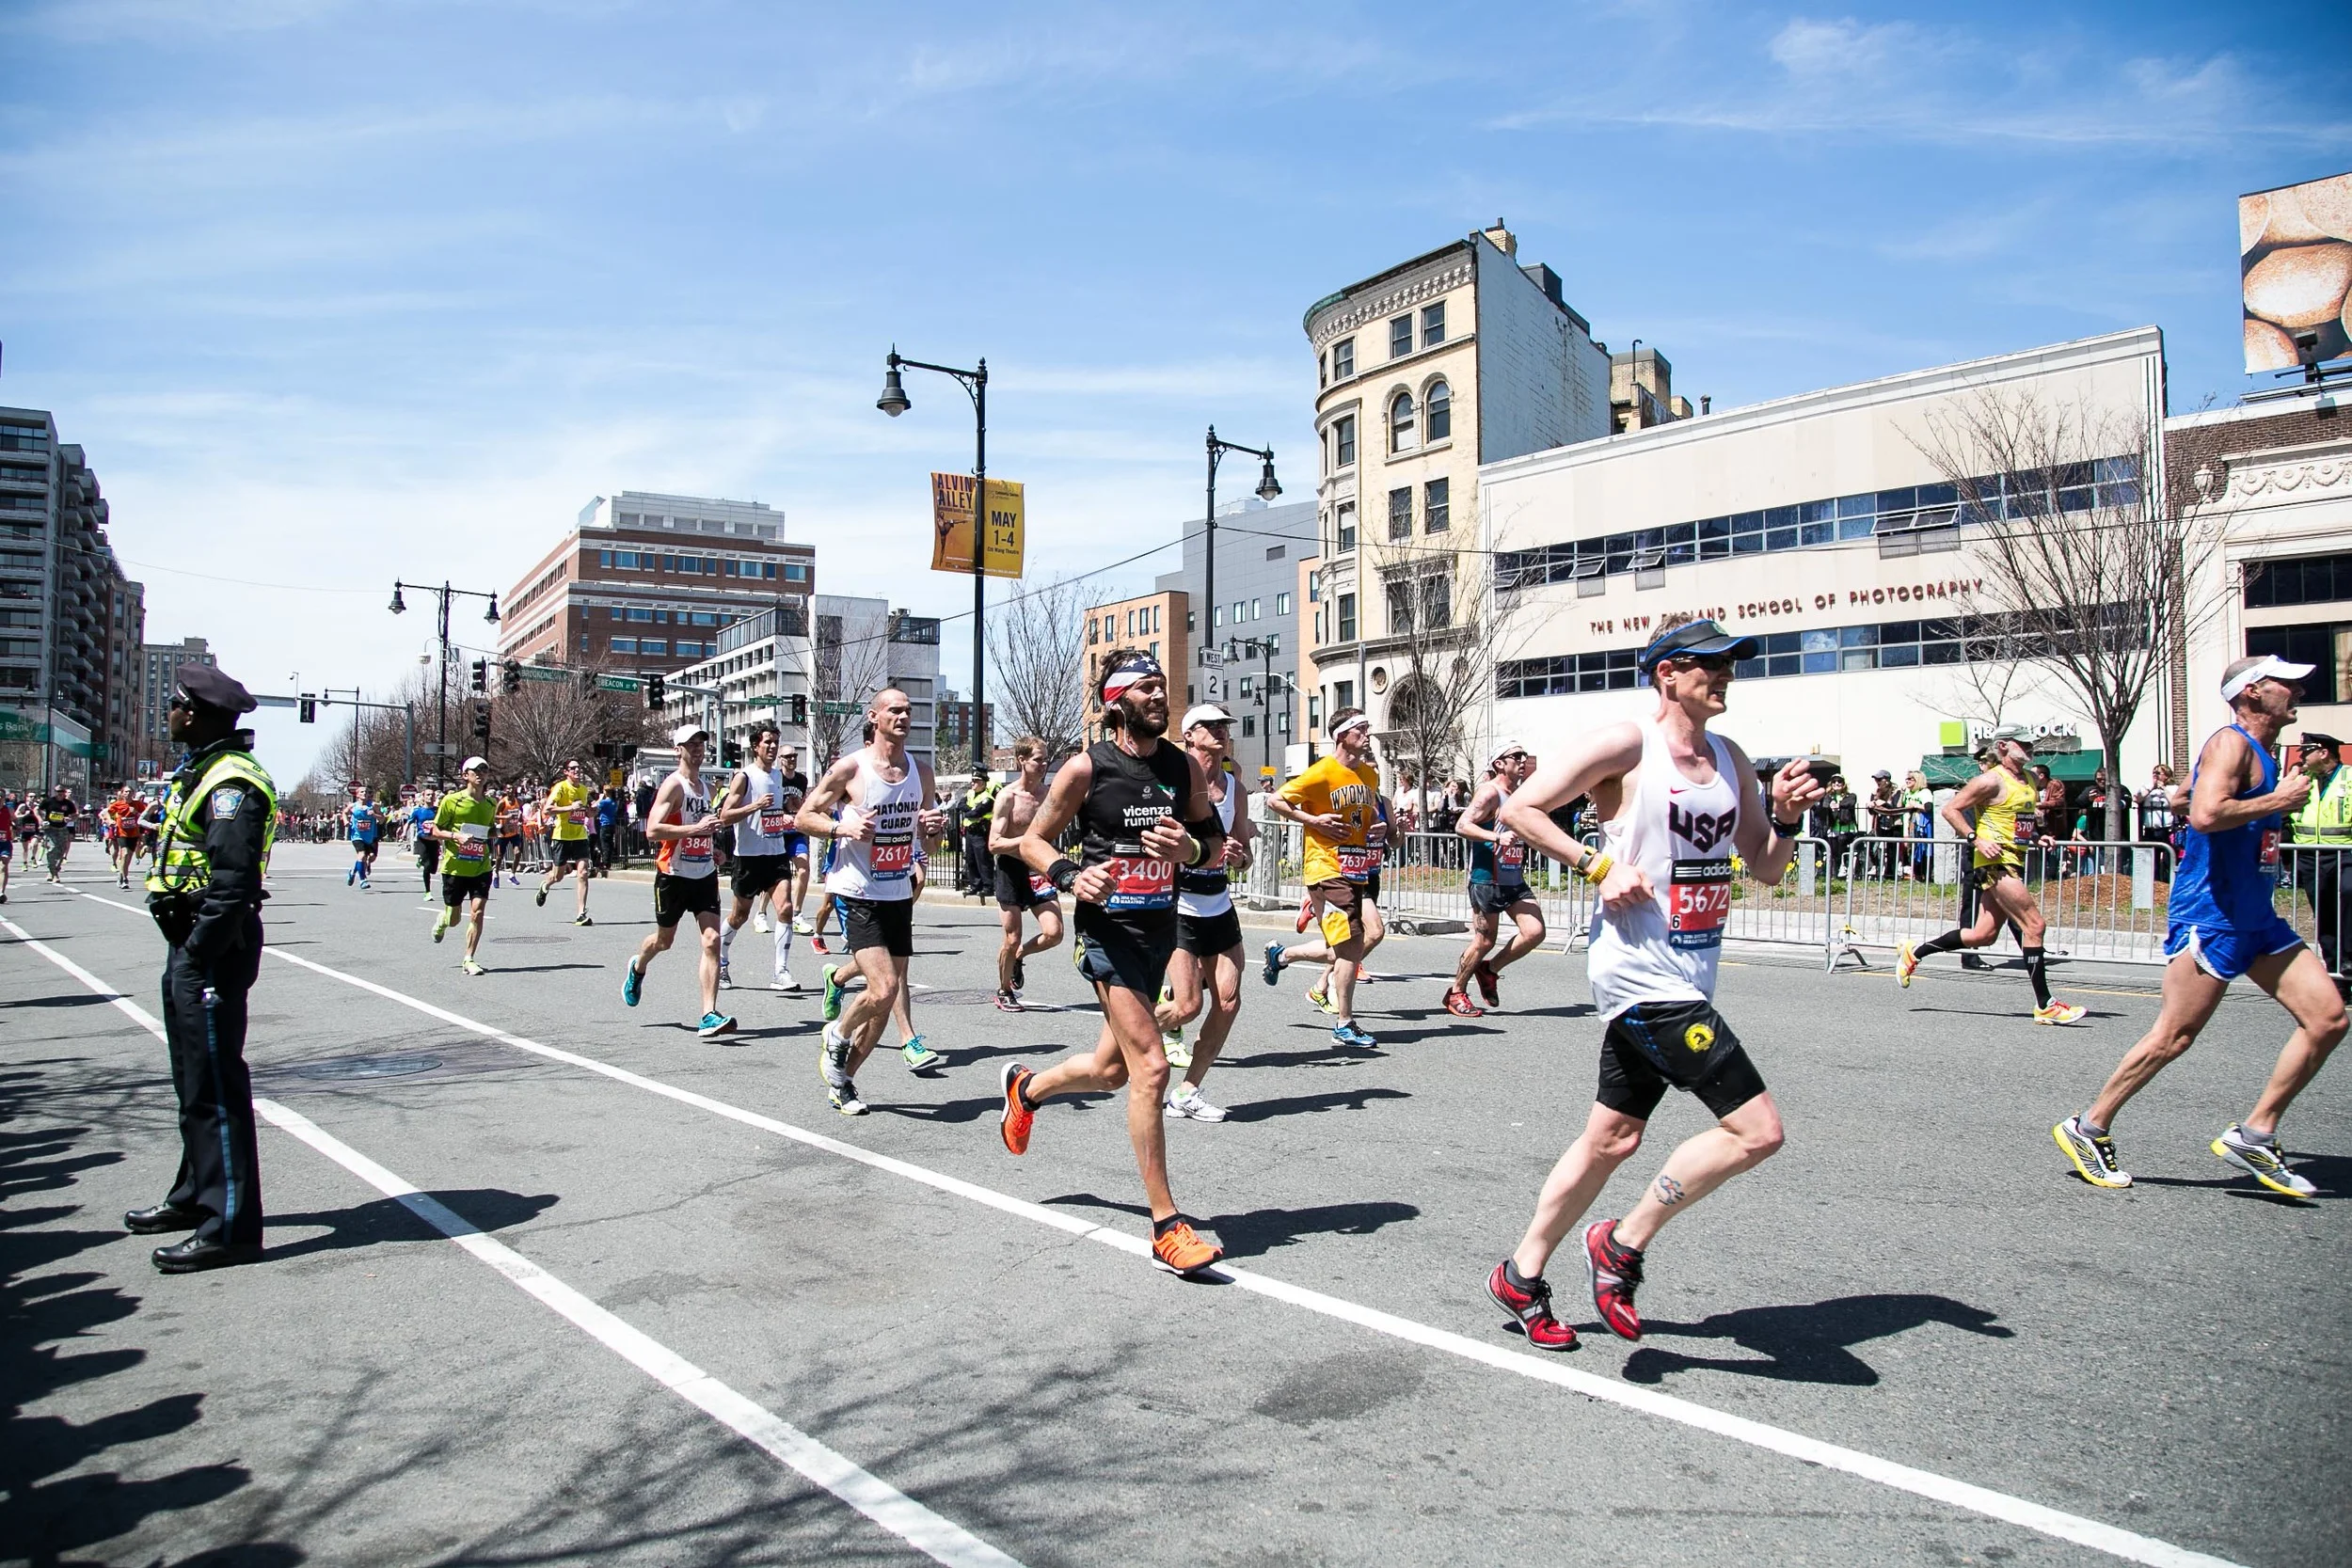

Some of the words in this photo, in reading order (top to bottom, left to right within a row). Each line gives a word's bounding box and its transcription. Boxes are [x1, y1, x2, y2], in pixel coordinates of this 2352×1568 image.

[938, 473, 973, 492] ALVIN
[938, 489, 973, 509] AILEY
[991, 510, 1017, 528] MAY
[993, 530, 1014, 546] 1-4
[1590, 620, 1613, 636] THE
[1623, 616, 1650, 632] NEW
[1738, 597, 1803, 619] SCHOOL
[1814, 594, 1836, 610] OF
[1850, 578, 1983, 607] PHOTOGRAPHY
[1205, 651, 1221, 664] WEST
[600, 679, 624, 688] BEACON
[1209, 675, 1217, 694] 2
[2026, 722, 2076, 737] LOCK
[1330, 784, 1374, 811] WYOMIN
[873, 801, 918, 816] NATIONAL
[1122, 805, 1172, 816] vicenza
[881, 816, 913, 829] GUARD
[1124, 816, 1162, 827] runne
[1669, 800, 1736, 854] USA
[876, 846, 910, 863] 2617
[1117, 860, 1172, 881] 3400
[1703, 863, 1732, 876] adida
[1678, 884, 1730, 914] 5672
[1672, 915, 1680, 928] 6
